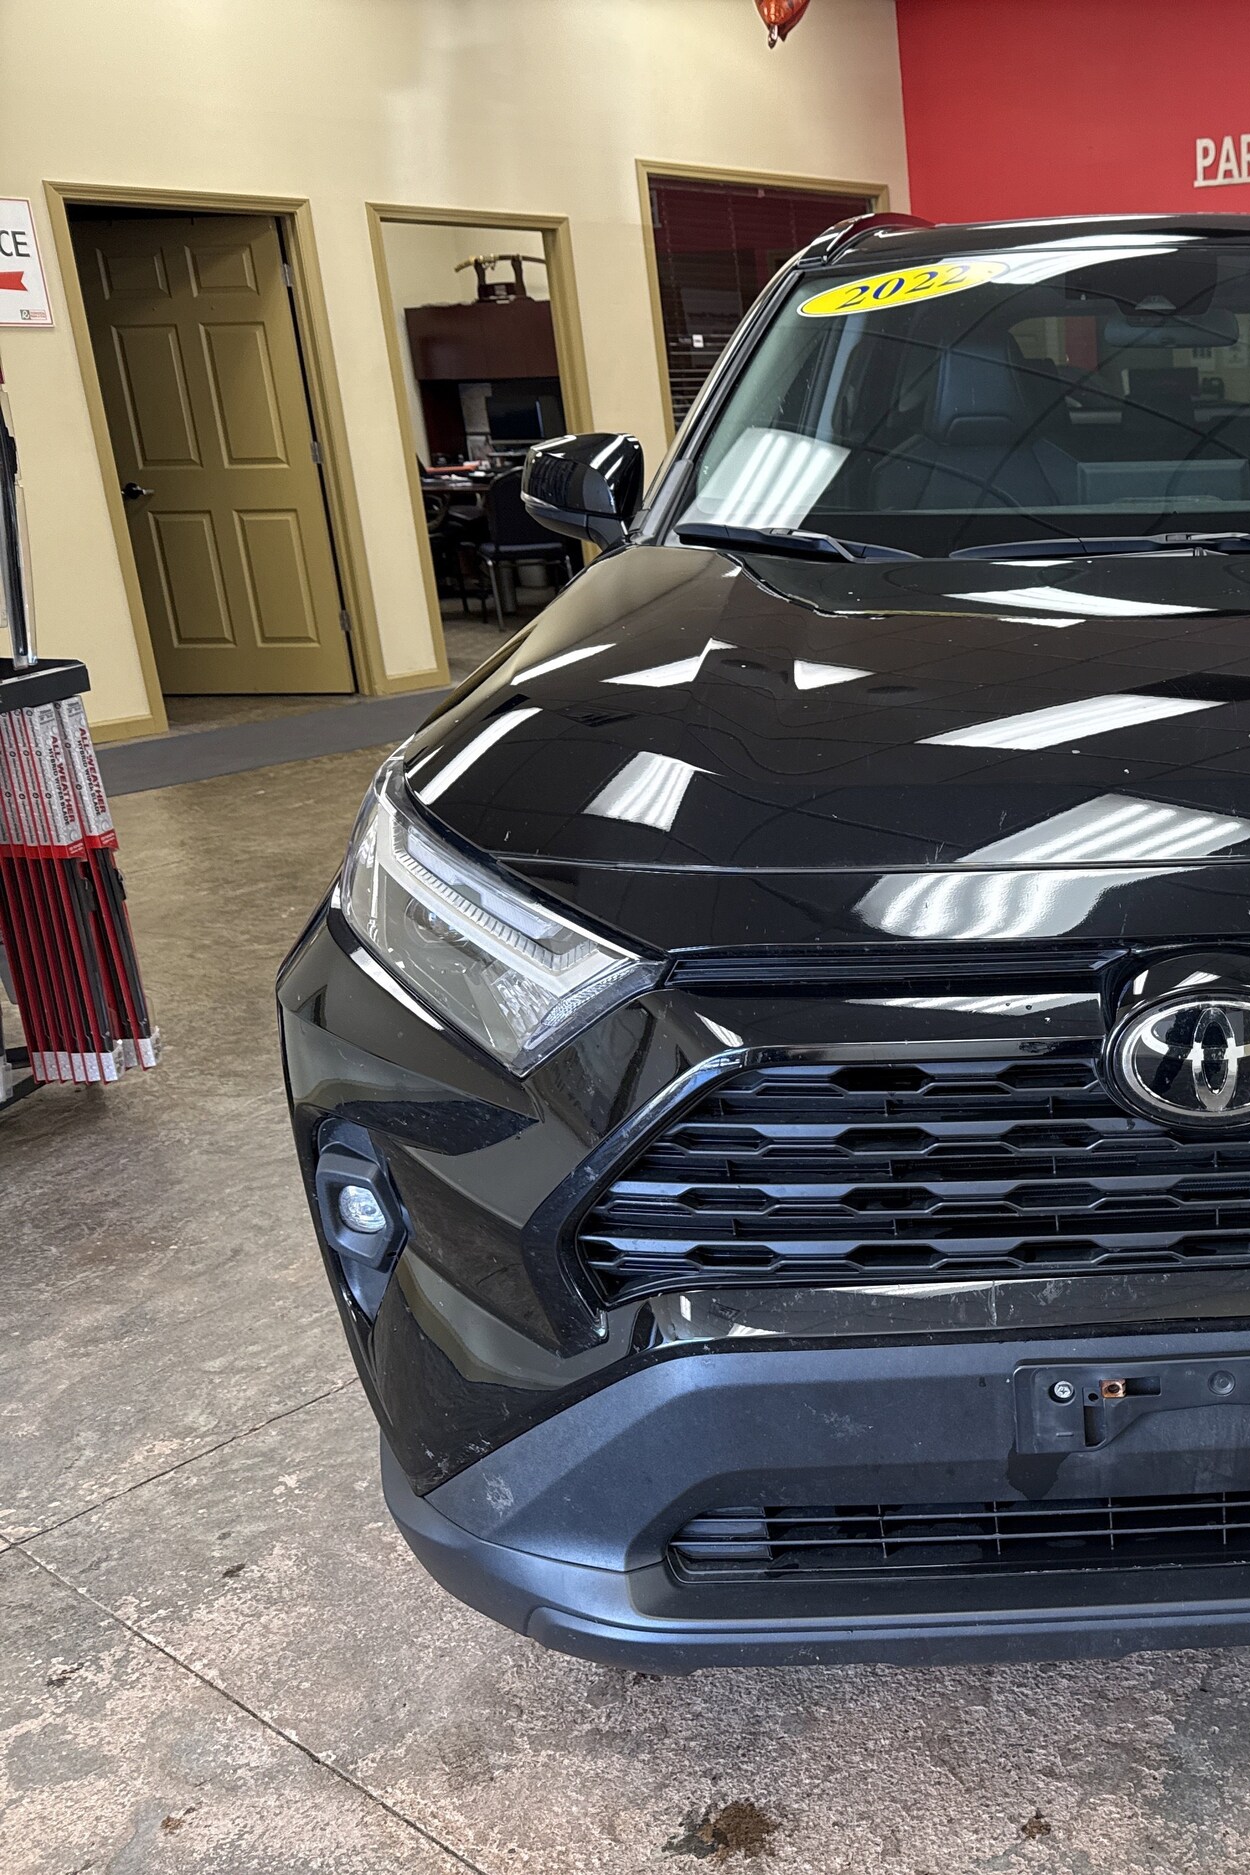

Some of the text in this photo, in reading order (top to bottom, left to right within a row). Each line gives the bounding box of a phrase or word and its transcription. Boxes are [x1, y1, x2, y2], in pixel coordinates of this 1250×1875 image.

[835, 265, 971, 311] 2022
[77, 740, 88, 769] HYBRID
[49, 748, 59, 776] HYBRID
[60, 800, 71, 826] BLADE
